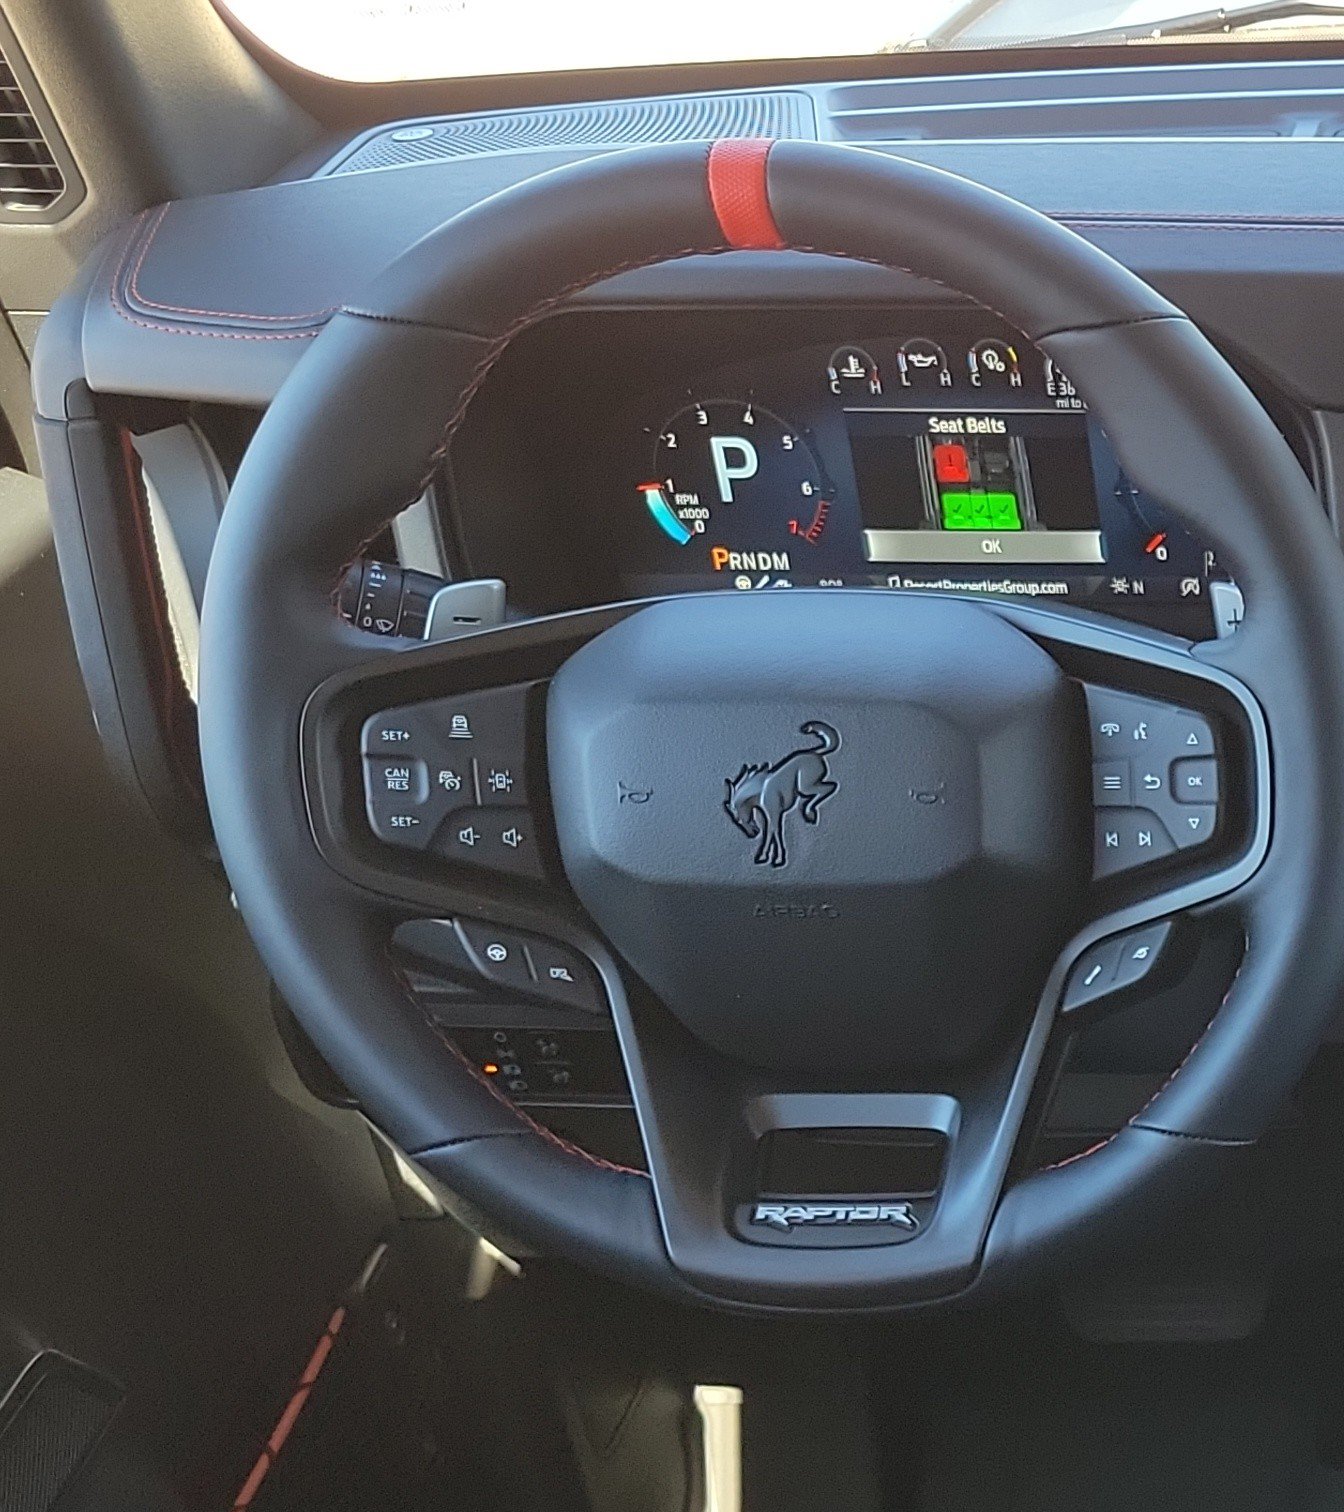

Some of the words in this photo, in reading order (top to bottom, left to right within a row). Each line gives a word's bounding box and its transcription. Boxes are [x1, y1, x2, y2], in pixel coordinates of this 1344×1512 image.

[901, 372, 911, 386] L
[940, 373, 952, 387] H
[971, 373, 981, 387] C
[1010, 372, 1022, 387] H
[830, 381, 842, 394] C
[870, 381, 882, 394] H
[1047, 382, 1056, 396] E
[697, 411, 708, 425] 3
[743, 411, 755, 425] 4
[929, 417, 964, 433] Seat
[966, 417, 1006, 434] Belts
[667, 433, 677, 448] 2
[782, 436, 793, 450] 5
[709, 436, 759, 503] P
[664, 478, 674, 493] 1
[802, 482, 813, 496] 6
[676, 494, 699, 505] RPM
[678, 508, 710, 520] x1000
[695, 520, 705, 534] 0
[981, 541, 1002, 553] OK
[1156, 547, 1168, 560] 0
[1132, 582, 1144, 595] N
[381, 731, 410, 741] SET+
[384, 768, 409, 777] CAN
[387, 781, 409, 790] RES
[1187, 776, 1202, 786] OK
[391, 817, 420, 827] SET-
[754, 1202, 917, 1233] RAPTOR
